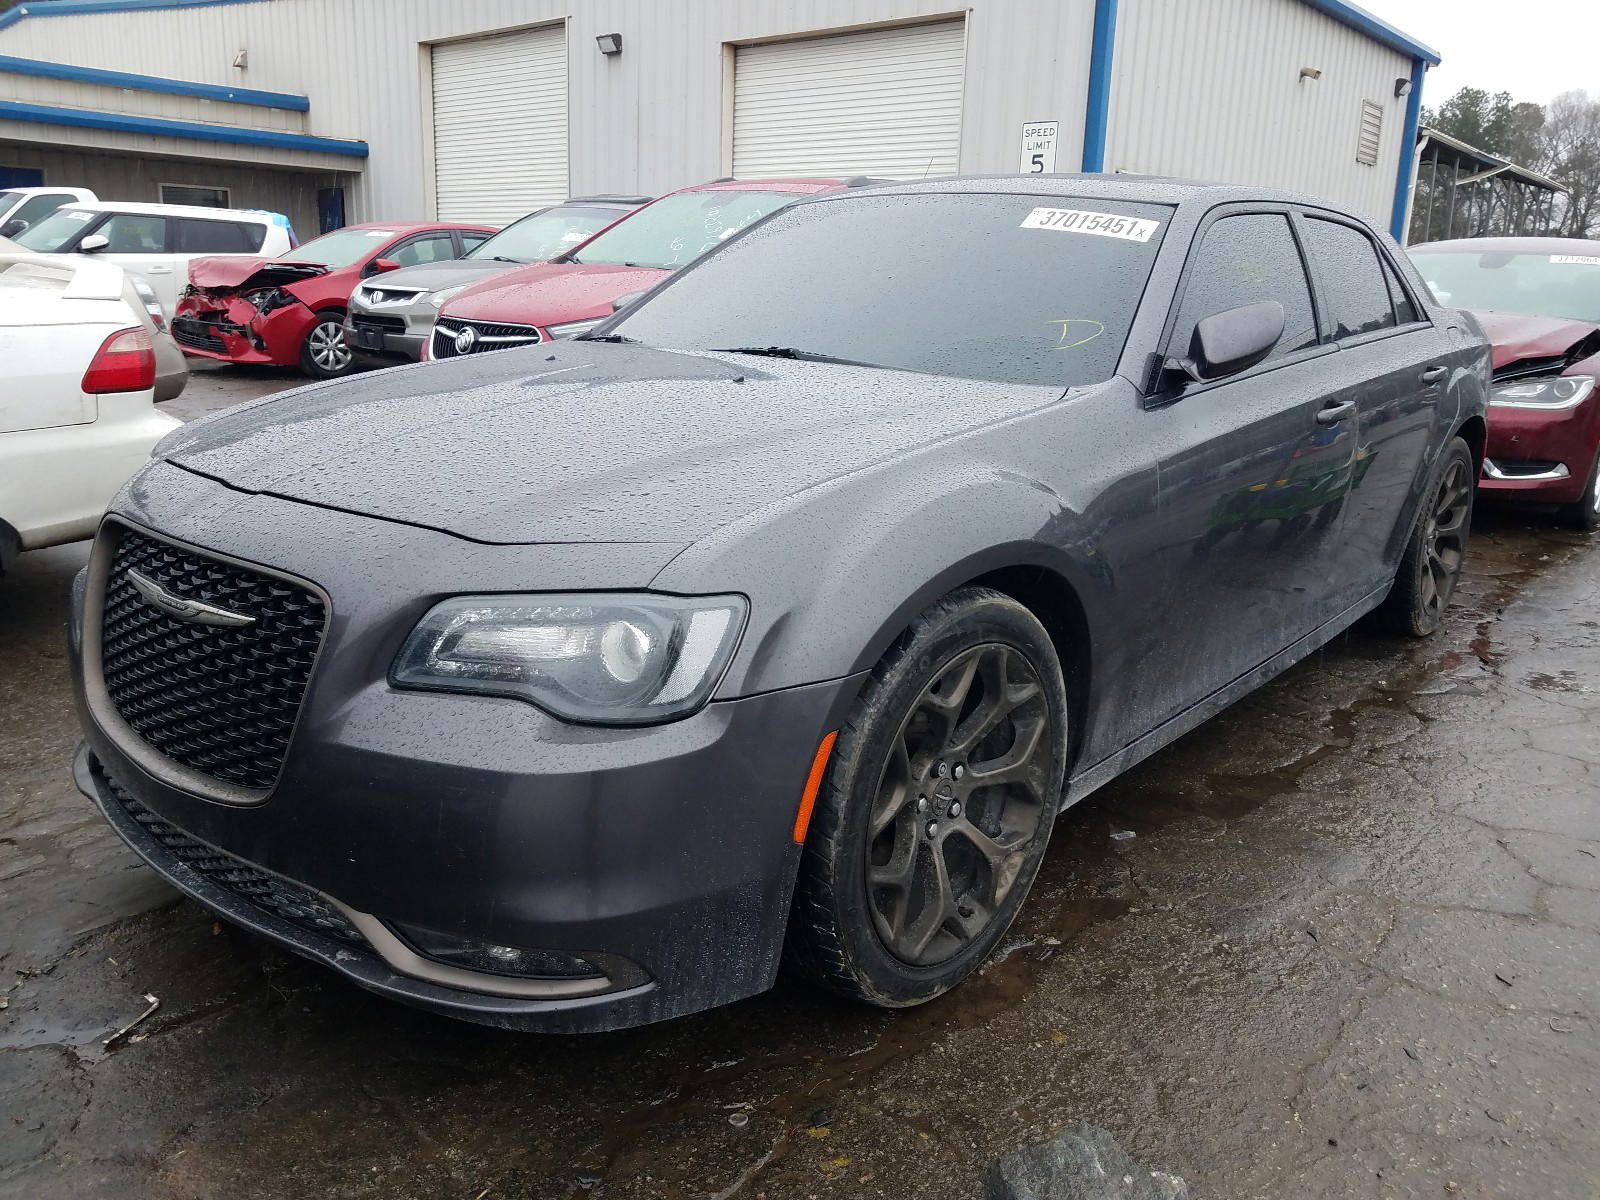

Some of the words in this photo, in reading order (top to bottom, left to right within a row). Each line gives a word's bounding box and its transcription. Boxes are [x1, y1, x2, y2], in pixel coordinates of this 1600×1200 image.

[1025, 128, 1055, 138] SPEED
[1027, 140, 1052, 151] LIMIT
[1031, 154, 1044, 174] 5
[1040, 211, 1140, 236] 37015451
